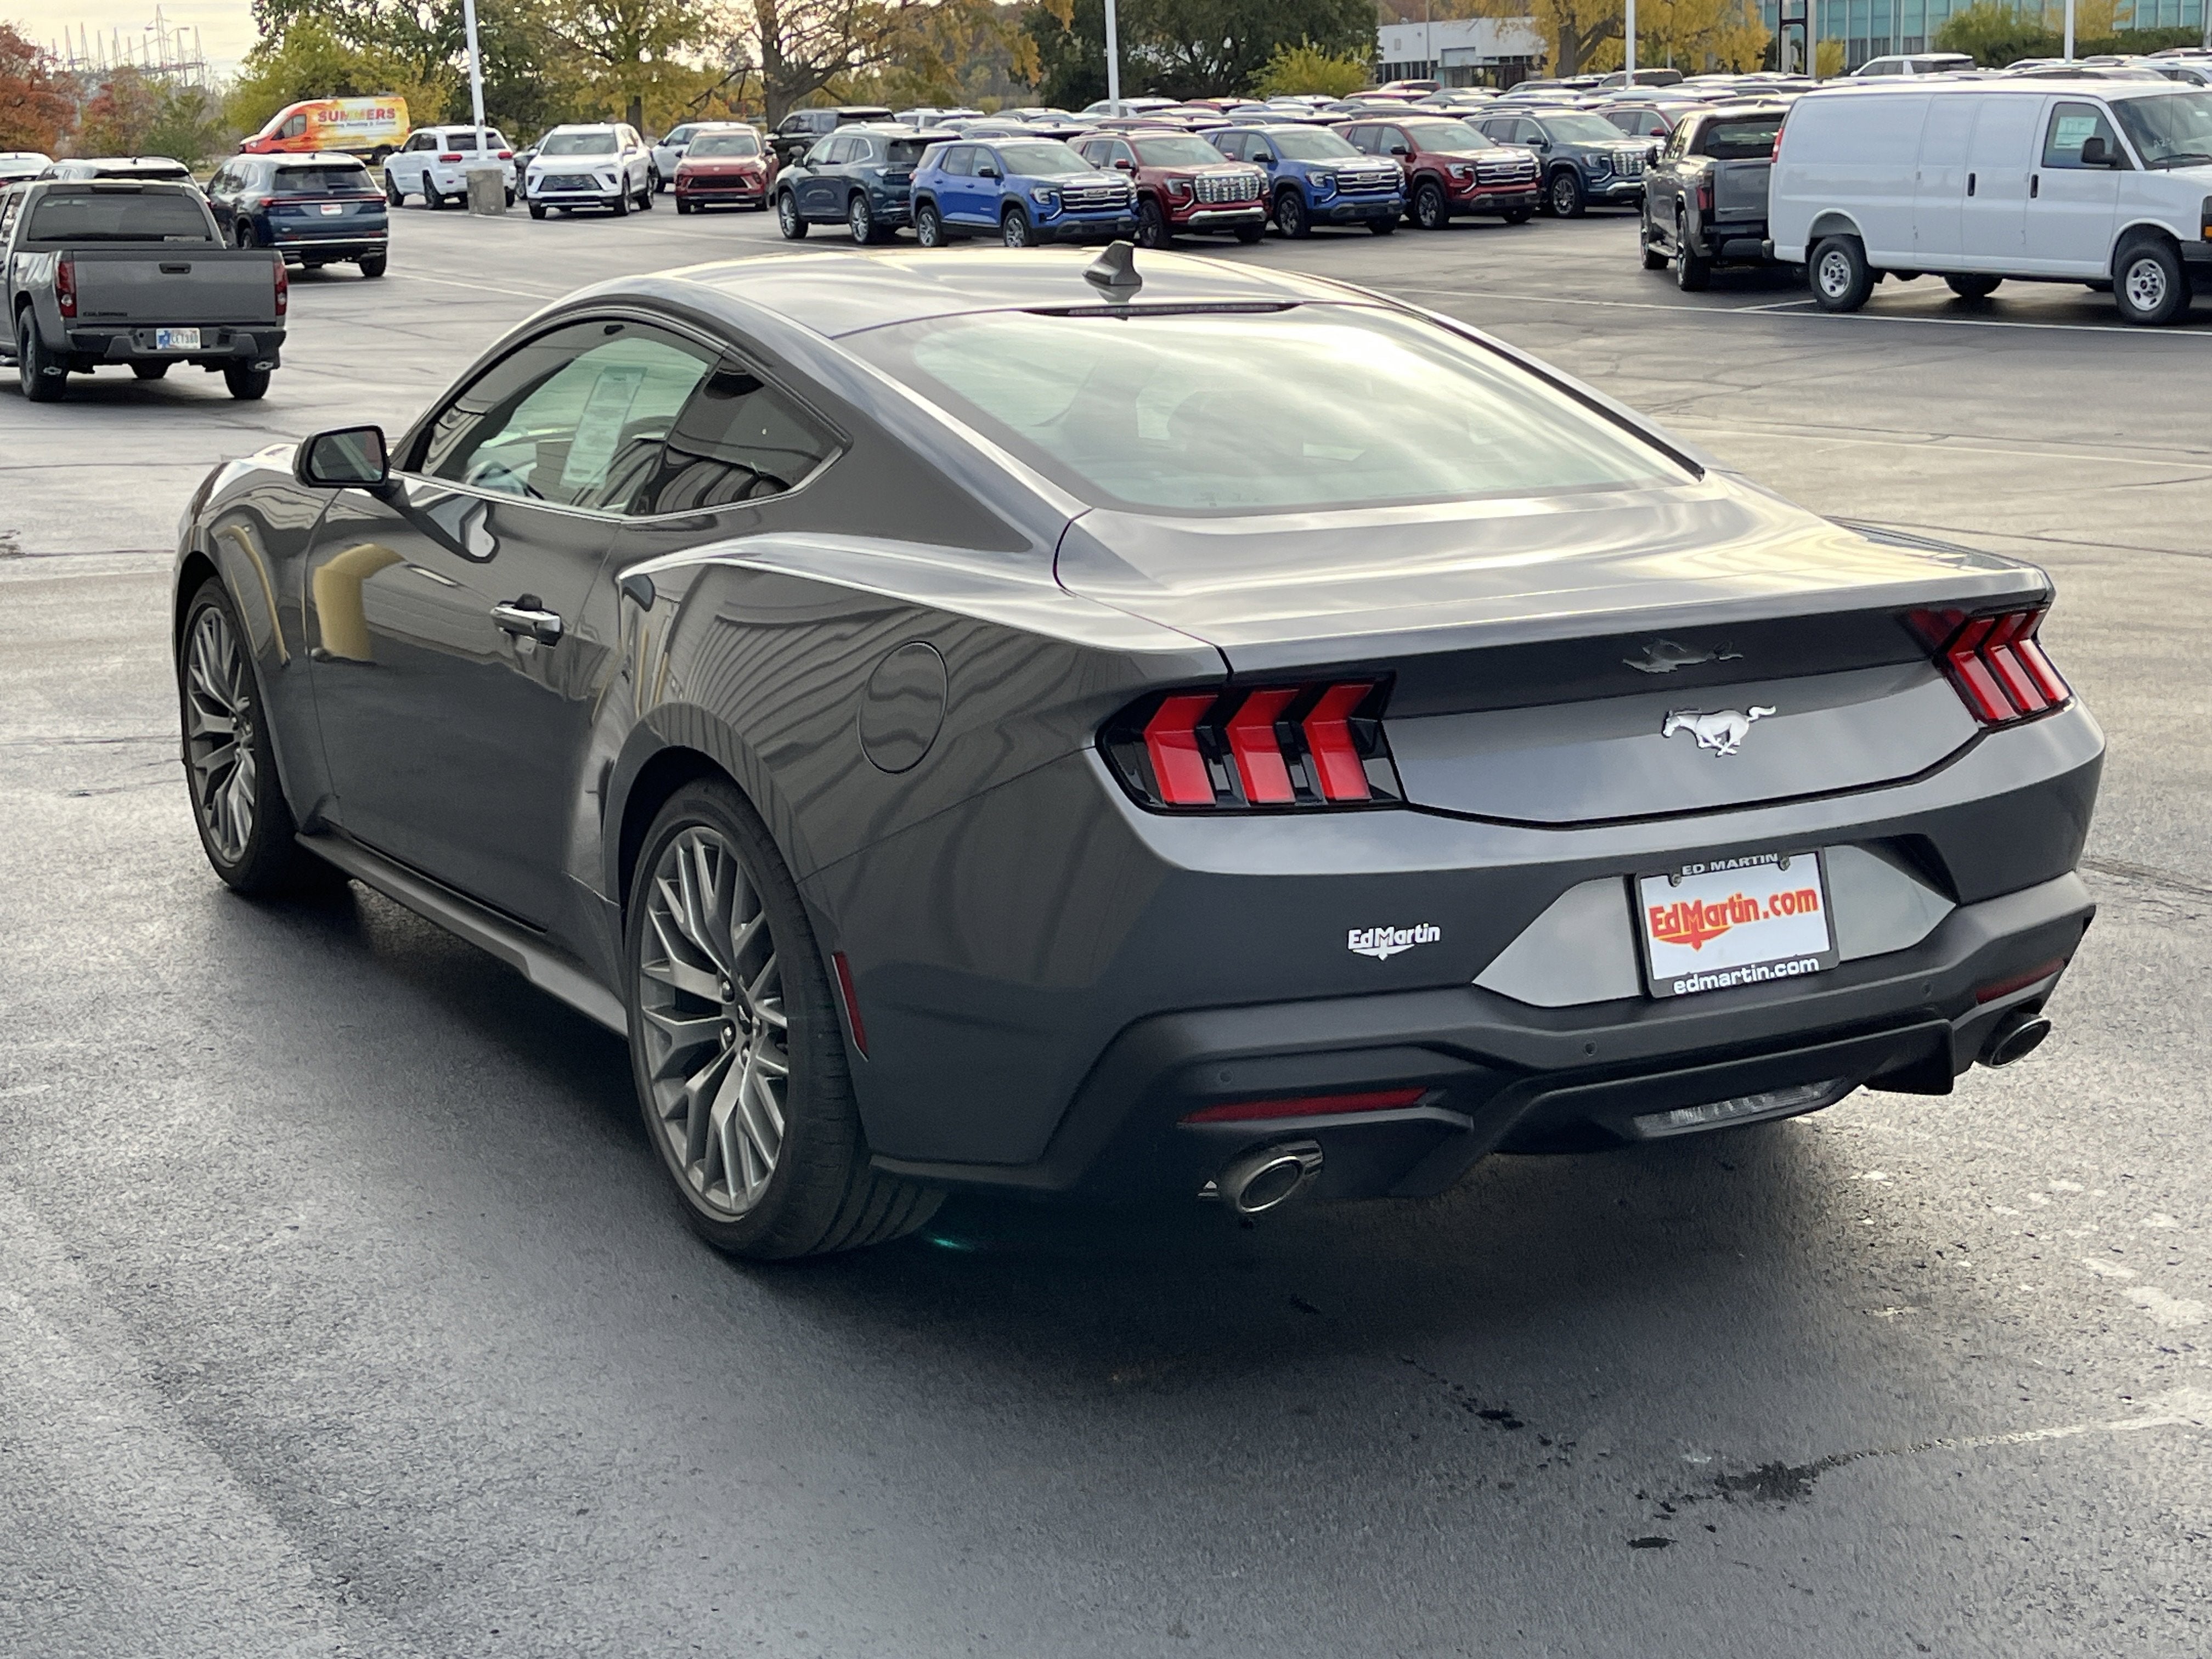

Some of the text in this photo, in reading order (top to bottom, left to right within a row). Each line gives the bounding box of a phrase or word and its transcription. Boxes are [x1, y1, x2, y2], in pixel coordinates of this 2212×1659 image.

[1681, 853, 1779, 877] ED MARTIN
[1649, 887, 1819, 935] EdMartin.com
[1347, 923, 1441, 950] EdMartin
[1673, 957, 1820, 995] edmartin.com
